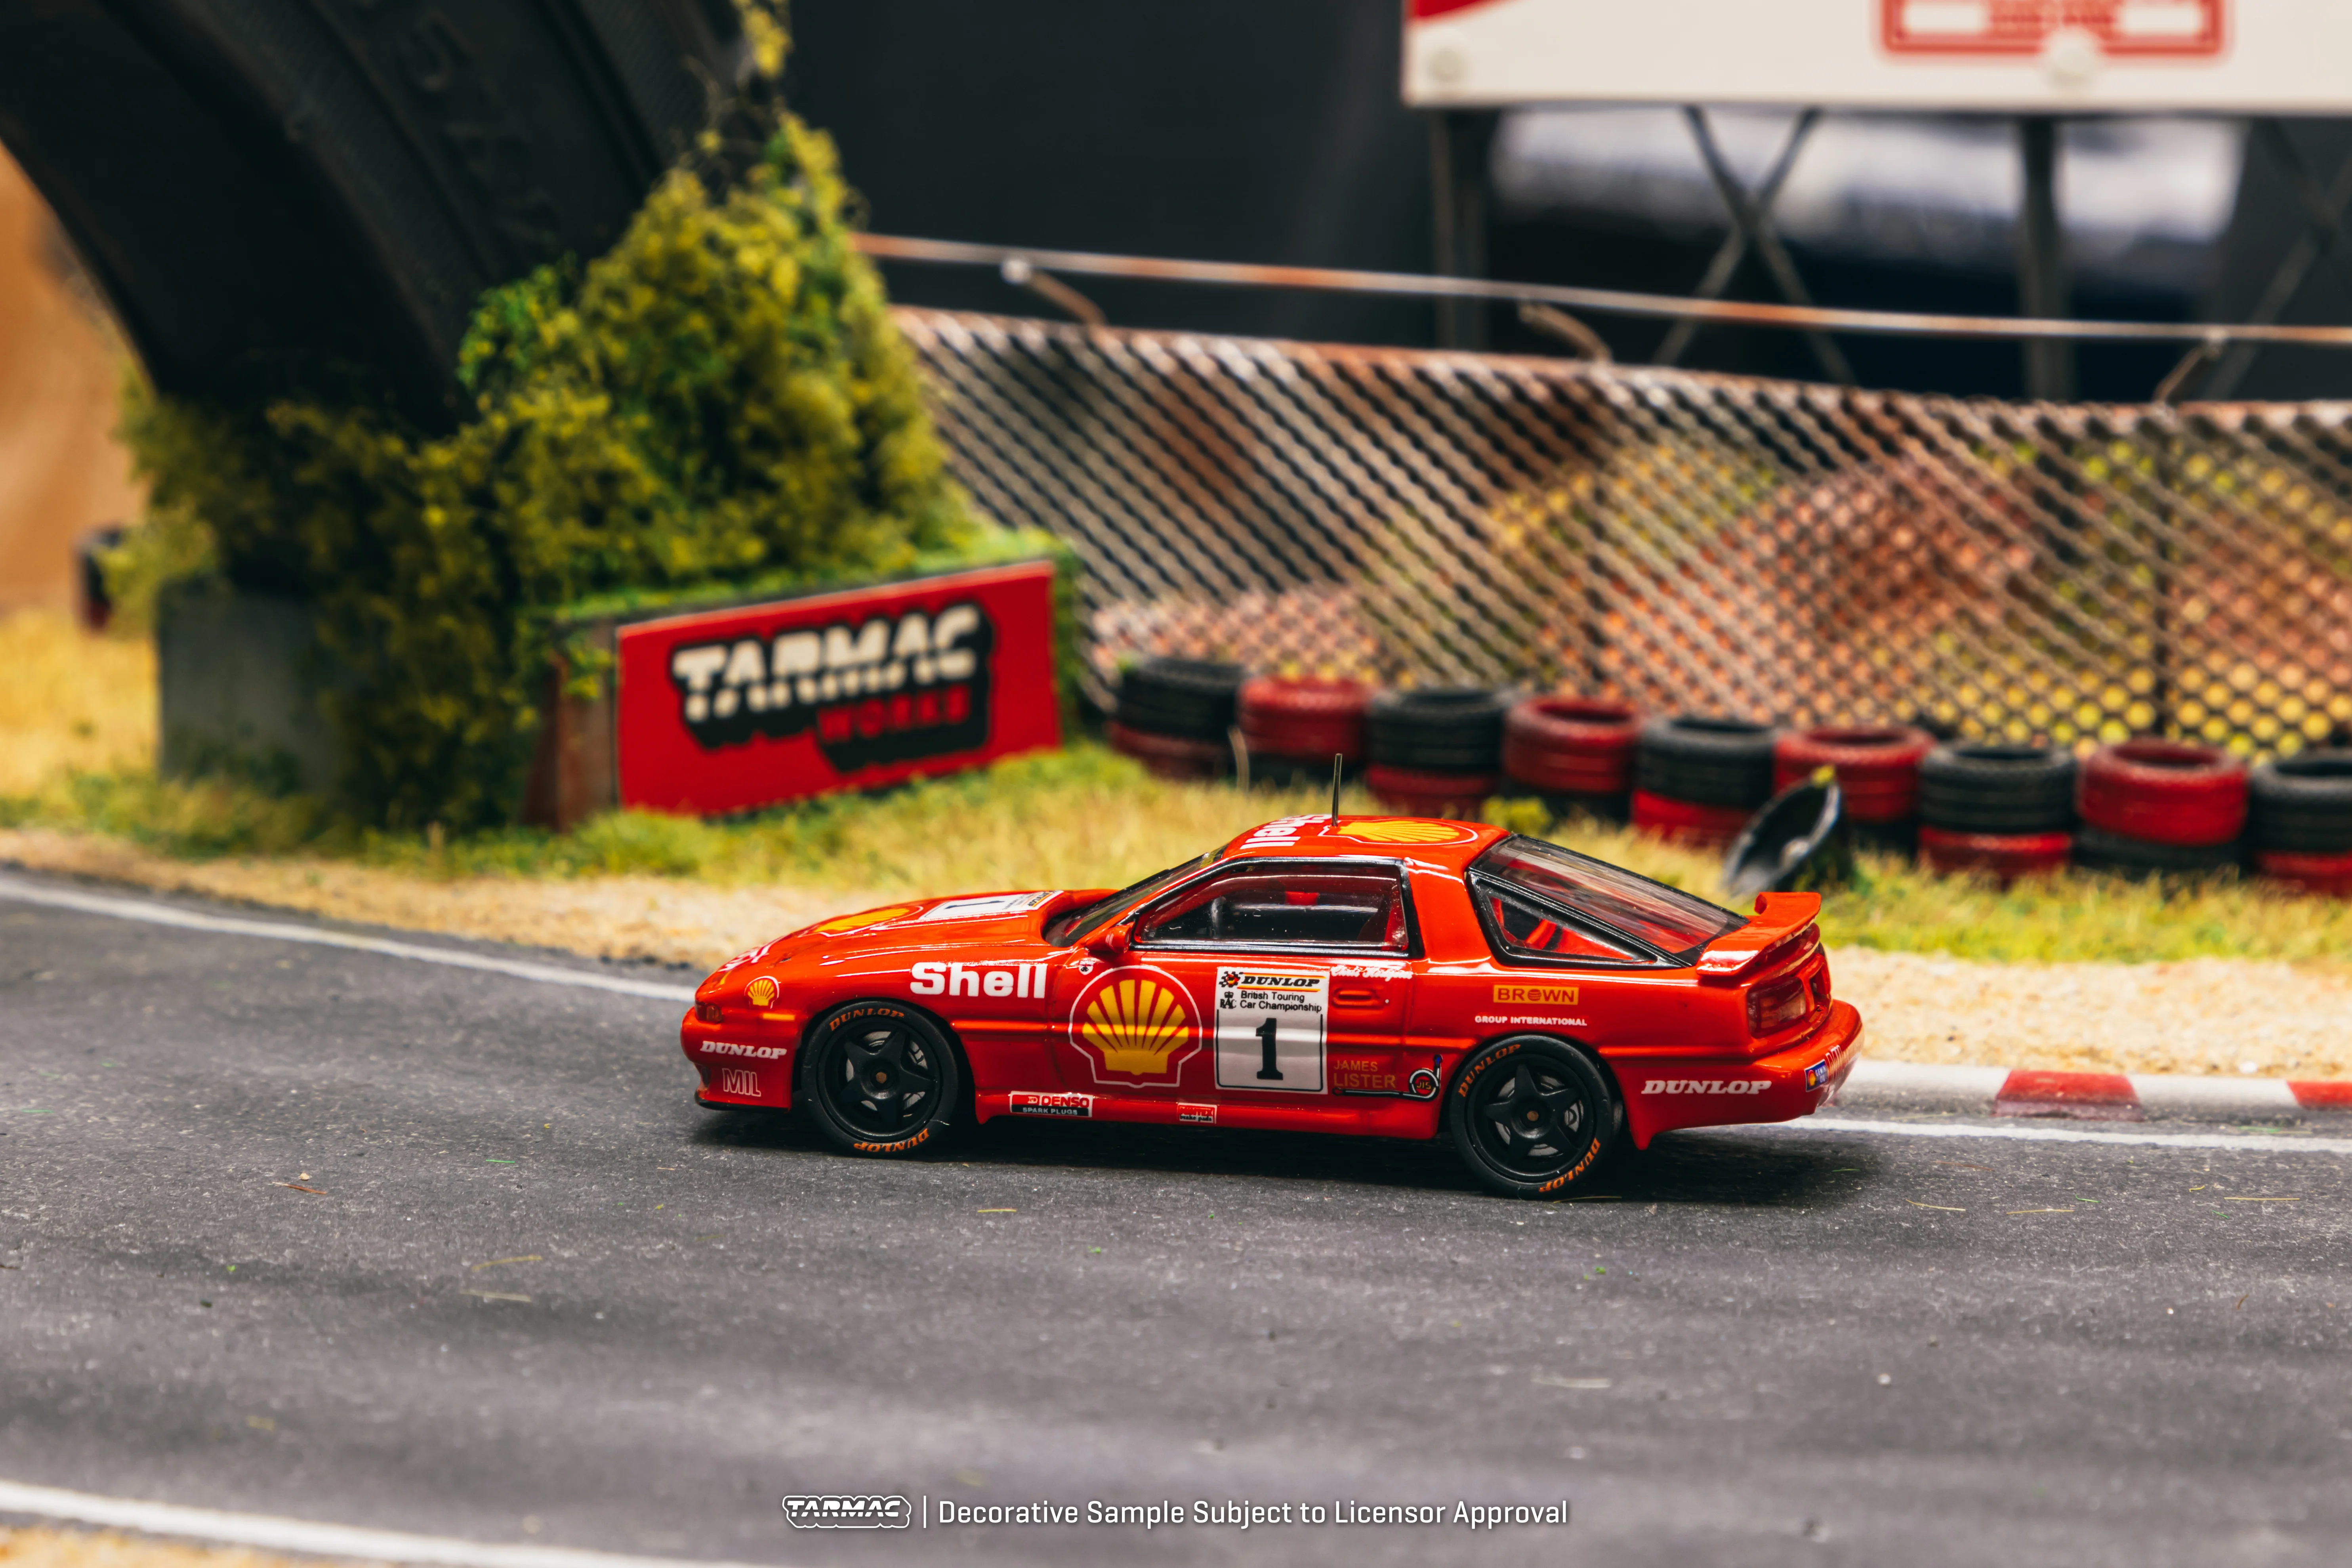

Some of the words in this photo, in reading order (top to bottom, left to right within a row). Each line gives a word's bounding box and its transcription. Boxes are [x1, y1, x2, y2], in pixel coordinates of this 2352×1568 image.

[670, 601, 982, 723] TARMAC
[910, 962, 1048, 999] Shell
[1241, 976, 1320, 987] DUNLOP
[1241, 990, 1269, 1000] British
[1272, 992, 1305, 1003] Touring
[1240, 1000, 1256, 1009] Car
[1259, 1001, 1322, 1013] Championship
[829, 1008, 904, 1031] DUNLOP
[1475, 1015, 1508, 1024] GROUP
[1511, 1017, 1587, 1026] INTERNATIONAL
[700, 1040, 788, 1059] DUNLOP
[1255, 1018, 1283, 1080] 1
[1333, 1060, 1378, 1072] JAMES
[1457, 1044, 1521, 1097] DUNLOP
[722, 1068, 761, 1097] MIL
[1333, 1073, 1396, 1089] LISTER
[1416, 1081, 1432, 1090] JIS
[1641, 1080, 1772, 1095] DUNLOP
[1041, 1095, 1090, 1108] DENSO
[853, 1128, 930, 1152] DUNLOP
[1539, 1137, 1601, 1192] DUNLOP
